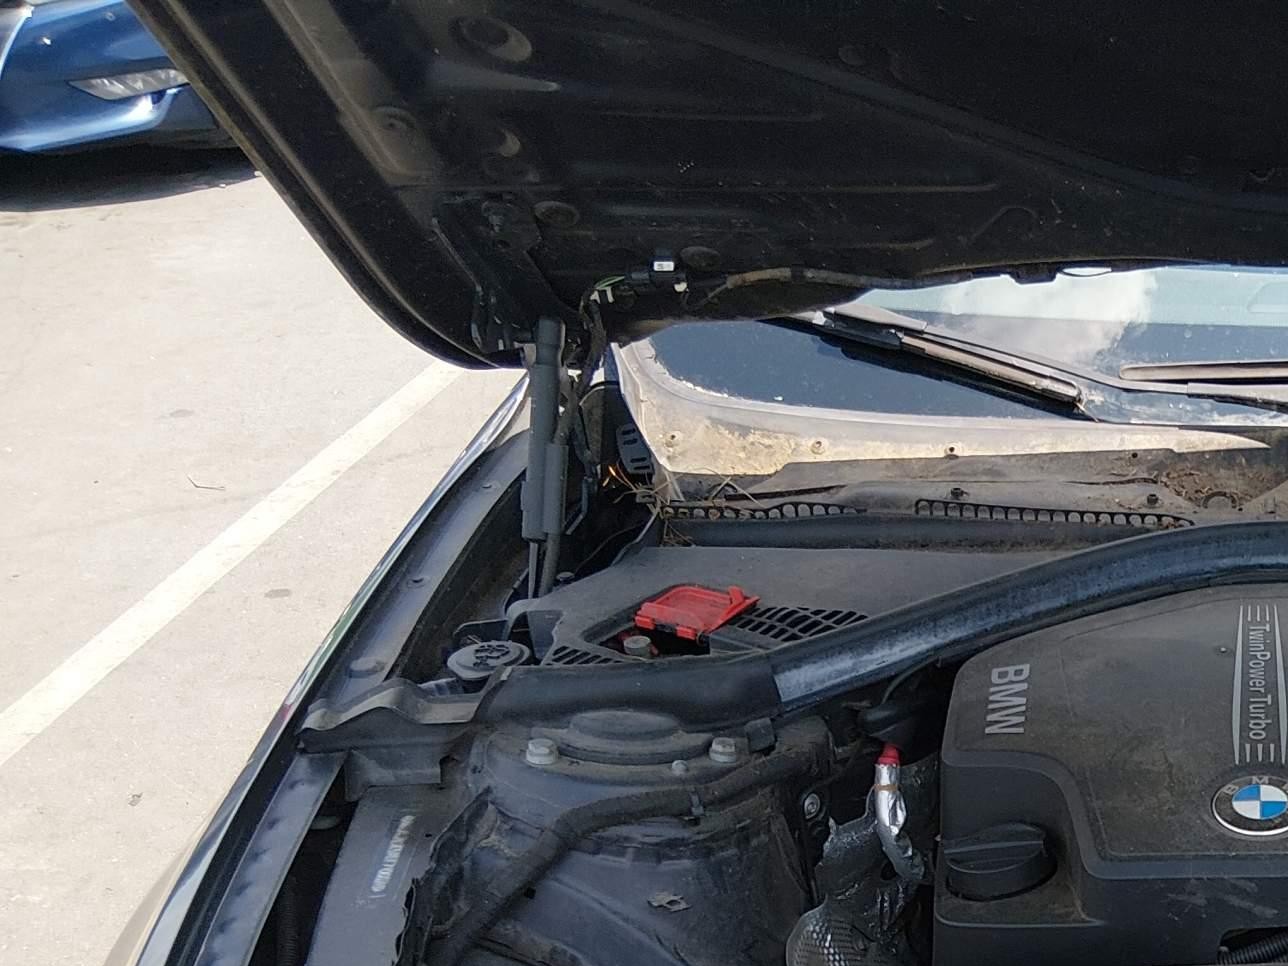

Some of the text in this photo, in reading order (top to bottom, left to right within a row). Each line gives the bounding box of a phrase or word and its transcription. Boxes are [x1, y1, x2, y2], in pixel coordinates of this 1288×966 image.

[984, 663, 1031, 734] BMW
[1248, 623, 1273, 741] TwinPower Turbo
